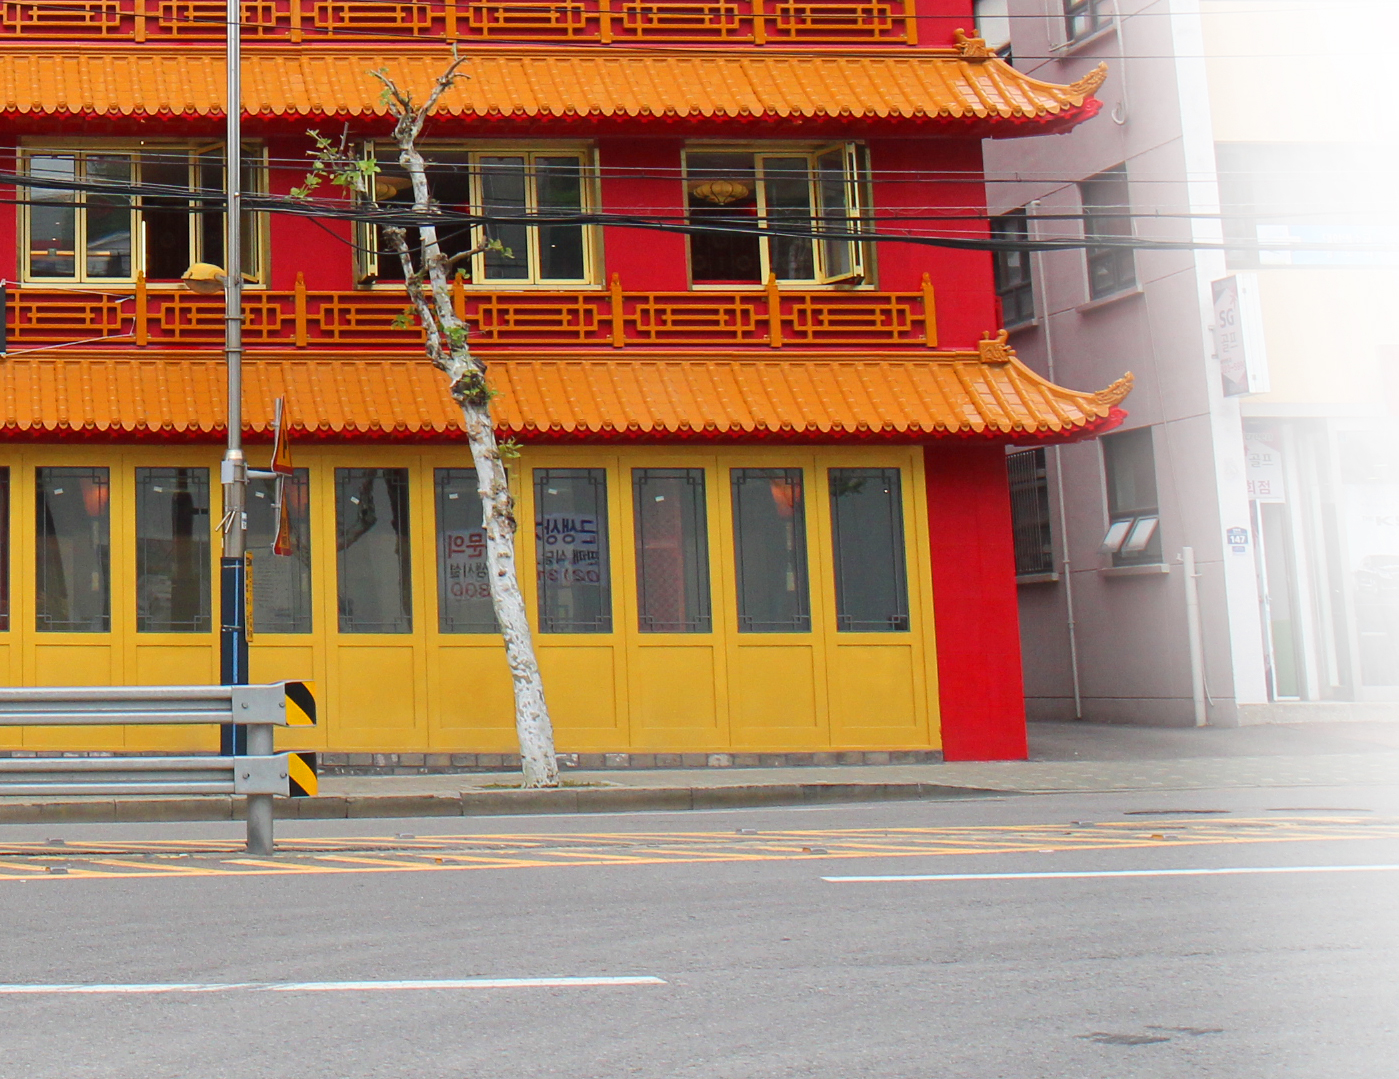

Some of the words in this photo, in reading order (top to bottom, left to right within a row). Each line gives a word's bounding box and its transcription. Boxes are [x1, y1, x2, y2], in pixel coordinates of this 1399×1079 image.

[1218, 307, 1235, 329] SG
[1248, 452, 1275, 468] 골프
[1229, 535, 1246, 544] 147
